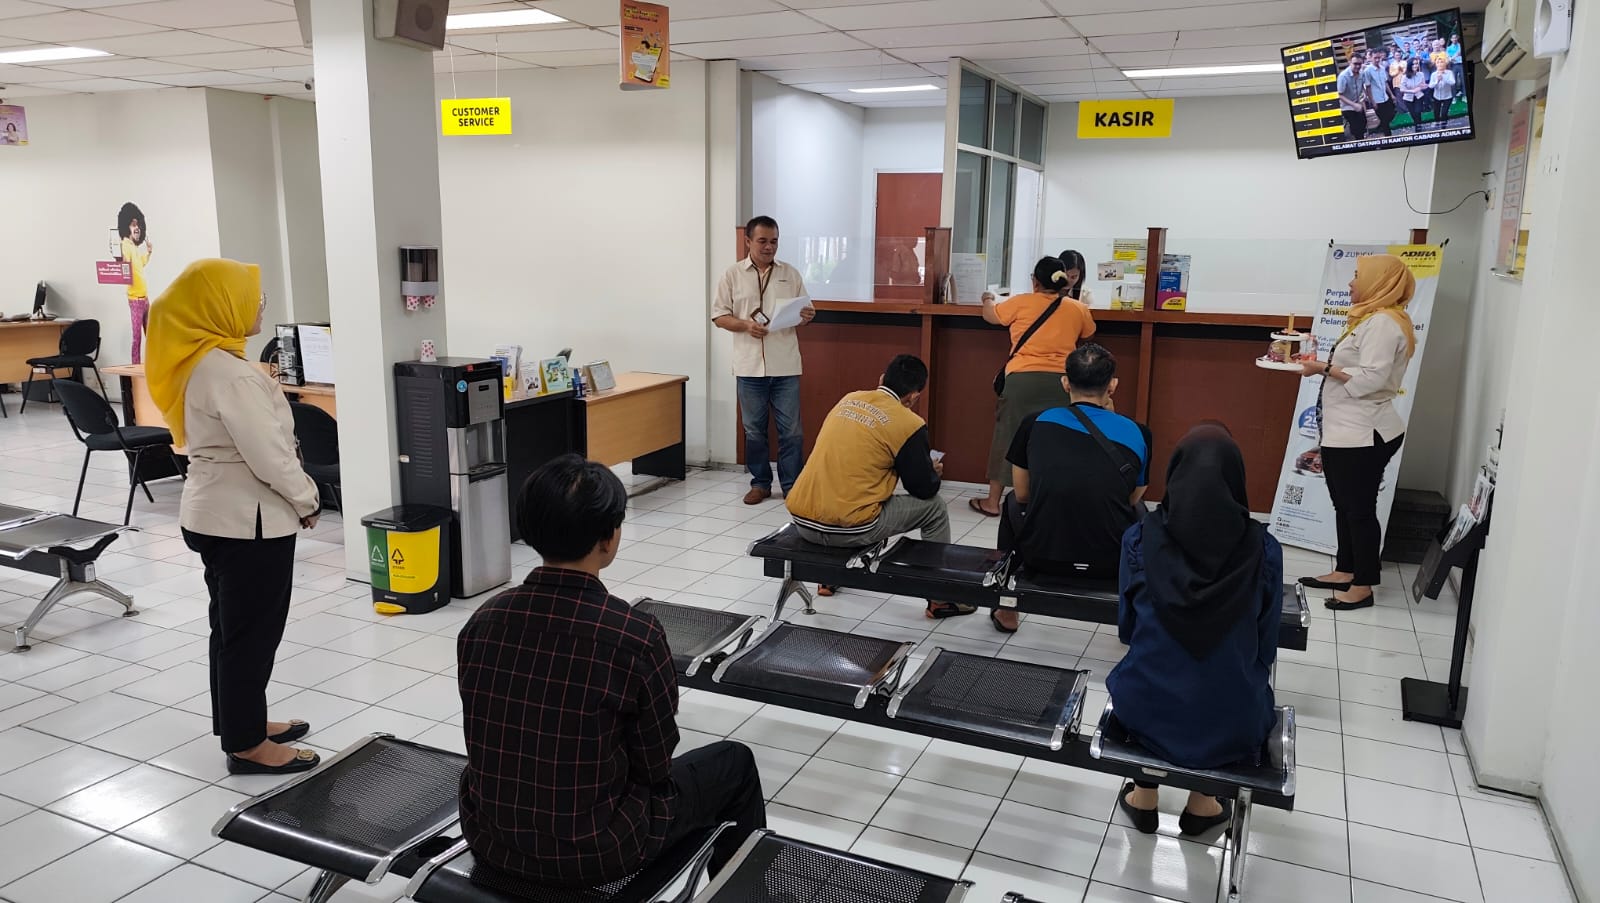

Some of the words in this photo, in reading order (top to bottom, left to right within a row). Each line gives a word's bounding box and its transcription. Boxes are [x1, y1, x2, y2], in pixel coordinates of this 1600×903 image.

[452, 106, 500, 116] CUSTOMER
[458, 117, 495, 127] SERVICE
[1094, 110, 1155, 127] KASIR
[1388, 136, 1413, 144] KANTOR
[1414, 132, 1440, 140] CABANG
[1441, 129, 1461, 137] ADIRA
[1115, 285, 1122, 297] 1
[1326, 288, 1351, 298] Perpa
[1324, 298, 1353, 307] Kendar
[1320, 317, 1347, 327] Pelang
